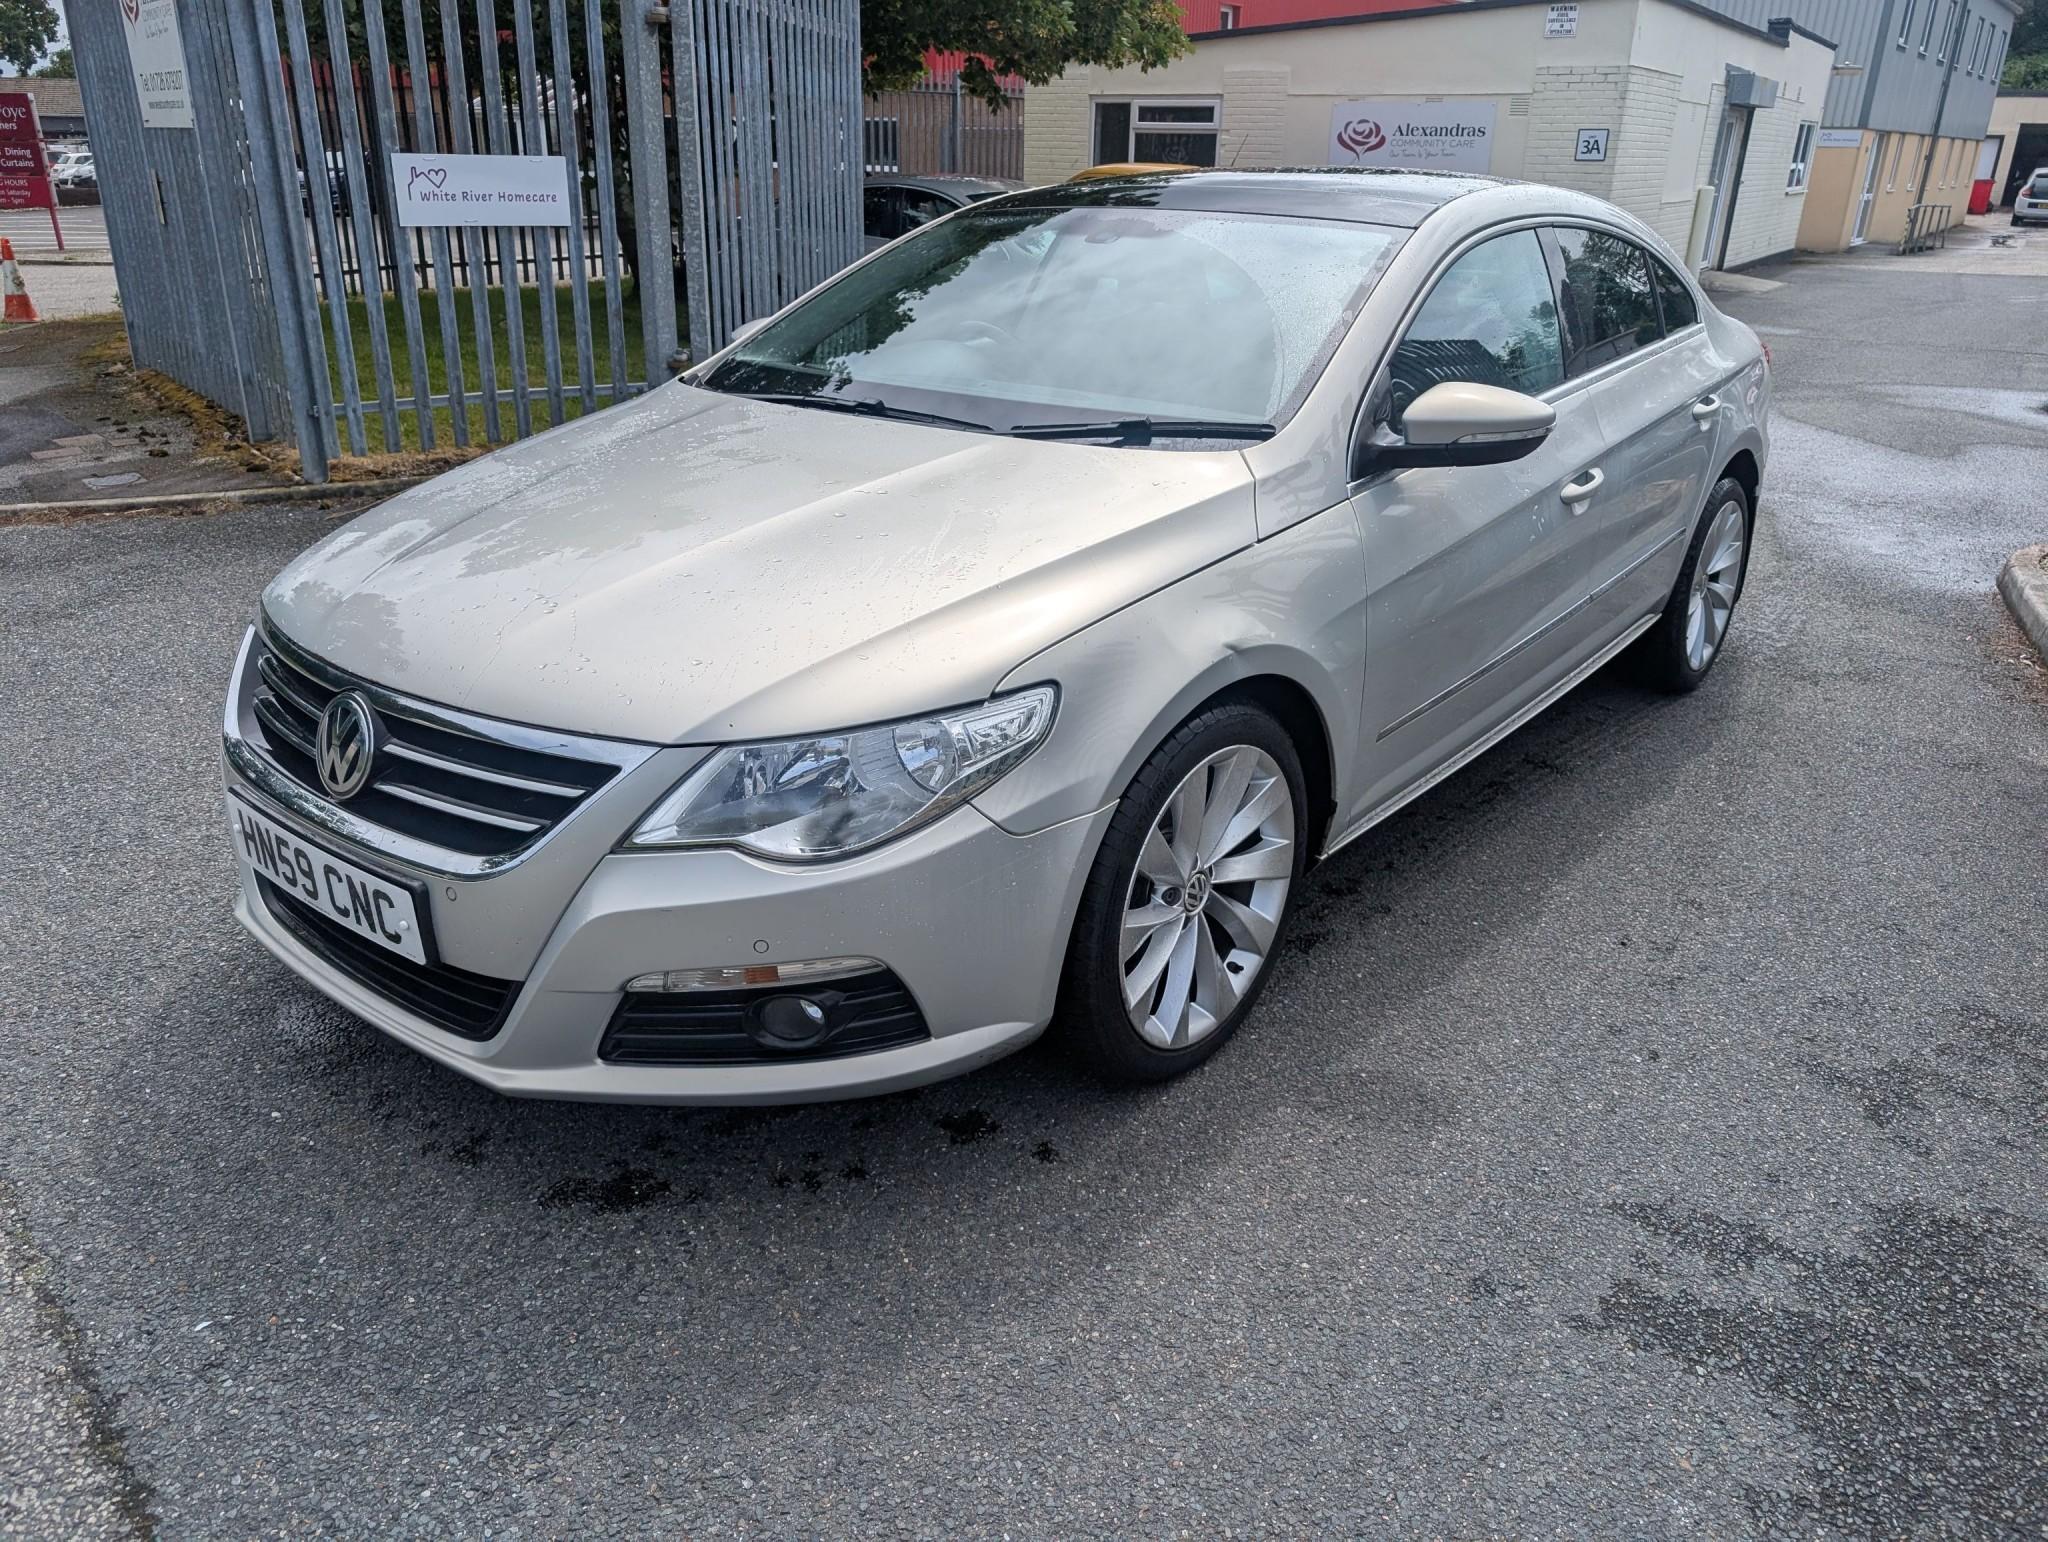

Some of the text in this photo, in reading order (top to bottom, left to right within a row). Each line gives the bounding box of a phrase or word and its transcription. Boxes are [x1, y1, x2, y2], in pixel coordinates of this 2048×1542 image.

[0, 106, 26, 122] oye
[1392, 123, 1486, 138] Alexandras
[1390, 139, 1476, 149] COMMUNITY CARE
[1580, 139, 1601, 155] 3A
[4, 147, 32, 158] Dining
[0, 158, 35, 167] Curtains
[4, 179, 28, 187] HOURS
[420, 190, 558, 203] White River Homecare
[237, 807, 402, 945] HN59 CNC
